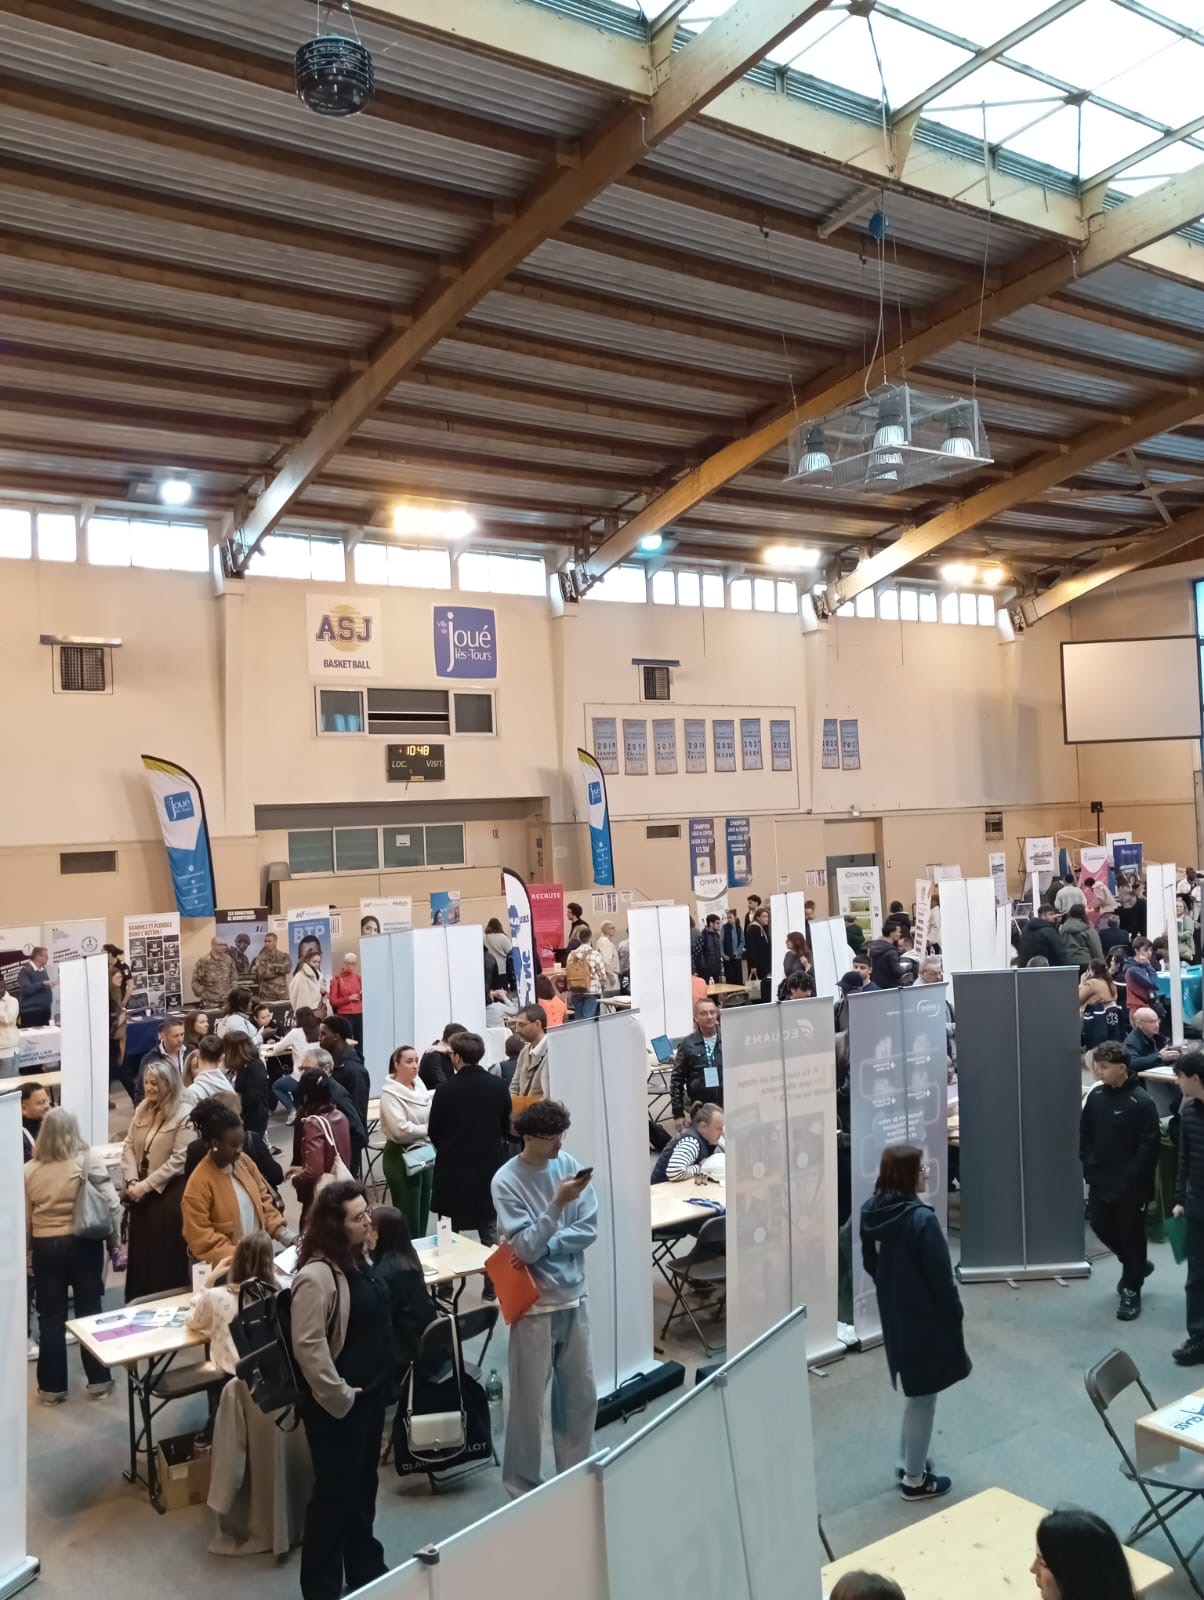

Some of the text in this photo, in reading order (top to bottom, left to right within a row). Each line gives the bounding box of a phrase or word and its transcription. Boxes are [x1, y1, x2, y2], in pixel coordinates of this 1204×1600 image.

[316, 614, 372, 642] ASJ
[323, 659, 370, 669] BASKETBALL
[531, 892, 561, 900] RECRUTE
[294, 924, 326, 944] BTP
